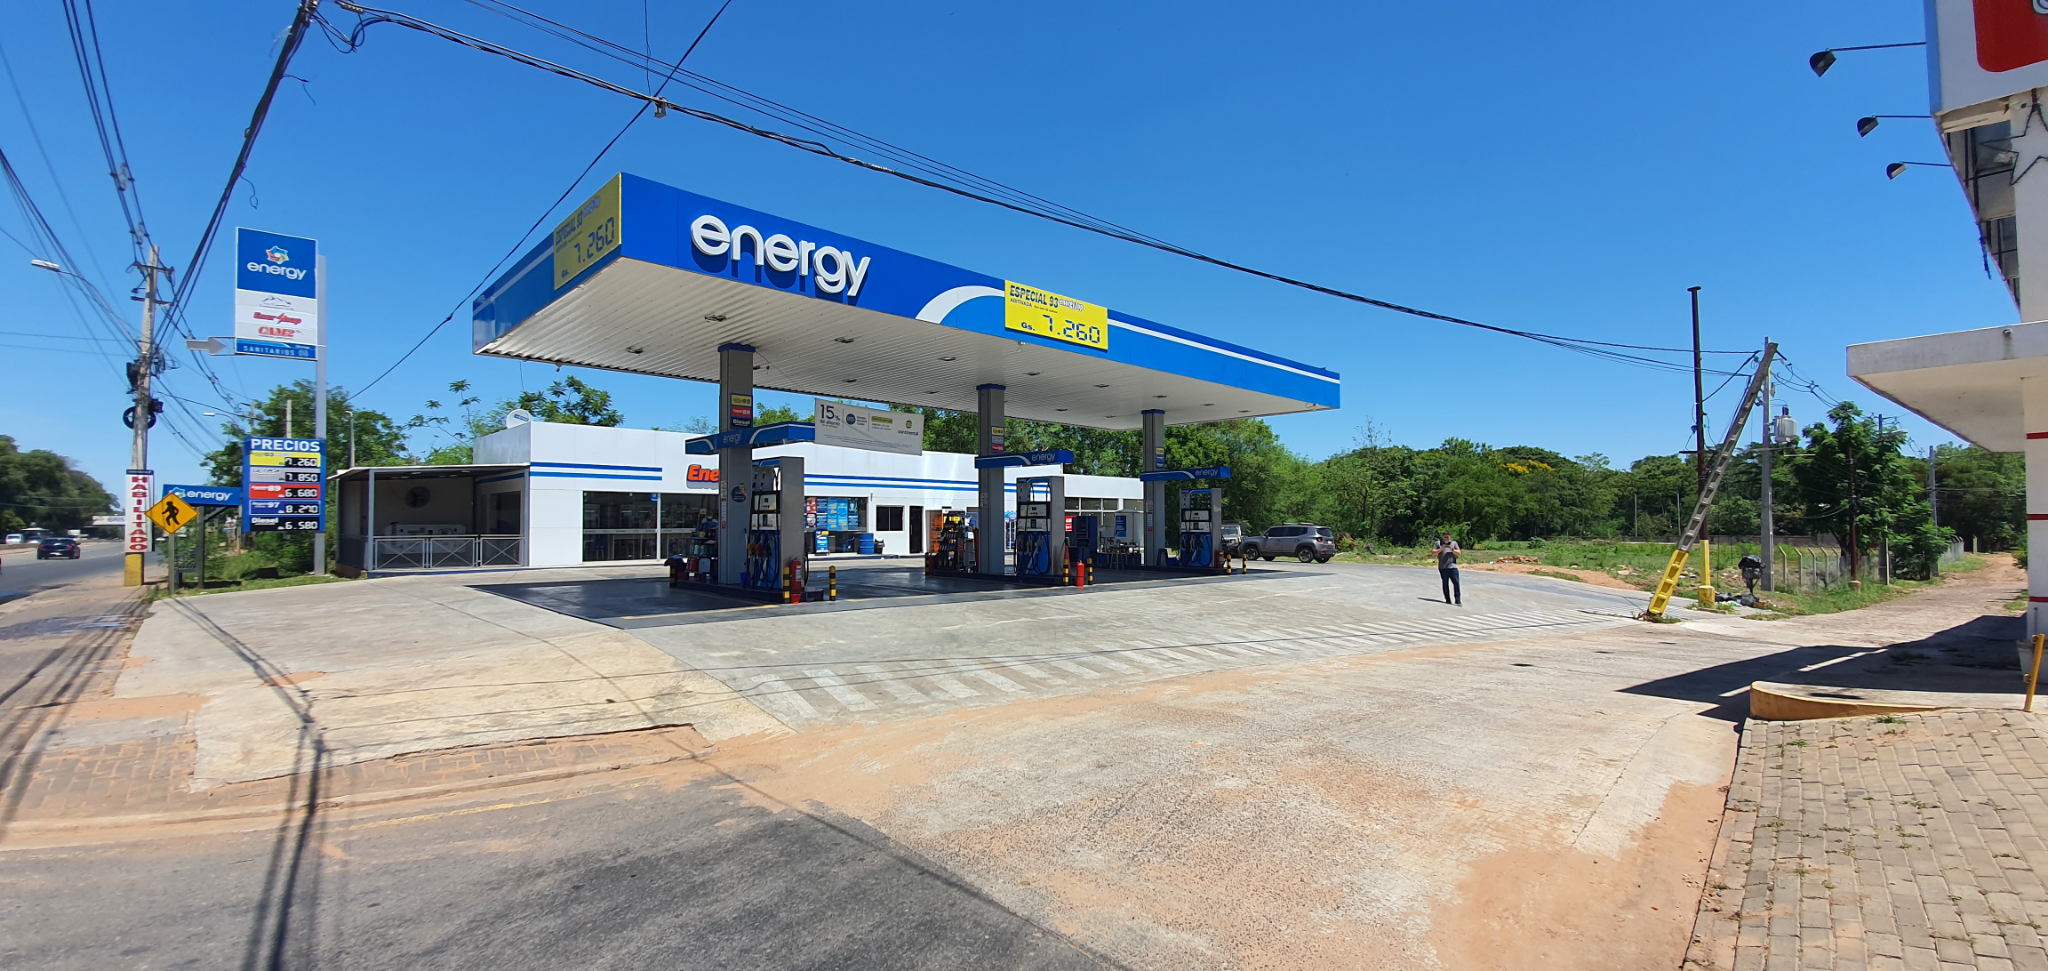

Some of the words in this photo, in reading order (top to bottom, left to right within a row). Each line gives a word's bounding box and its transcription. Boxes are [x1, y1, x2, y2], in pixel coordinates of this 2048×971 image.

[691, 214, 871, 296] energy
[247, 262, 307, 280] energy
[1010, 285, 1048, 306] ESPECIAL
[1049, 296, 1059, 308] 93
[1042, 314, 1100, 343] 7.260
[243, 345, 295, 356] SANITARIOS
[250, 438, 320, 452] PRECIOS
[1031, 452, 1056, 463] energy
[1195, 468, 1219, 478] energy
[186, 490, 233, 501] energy
[129, 476, 148, 551] HABILITADO
